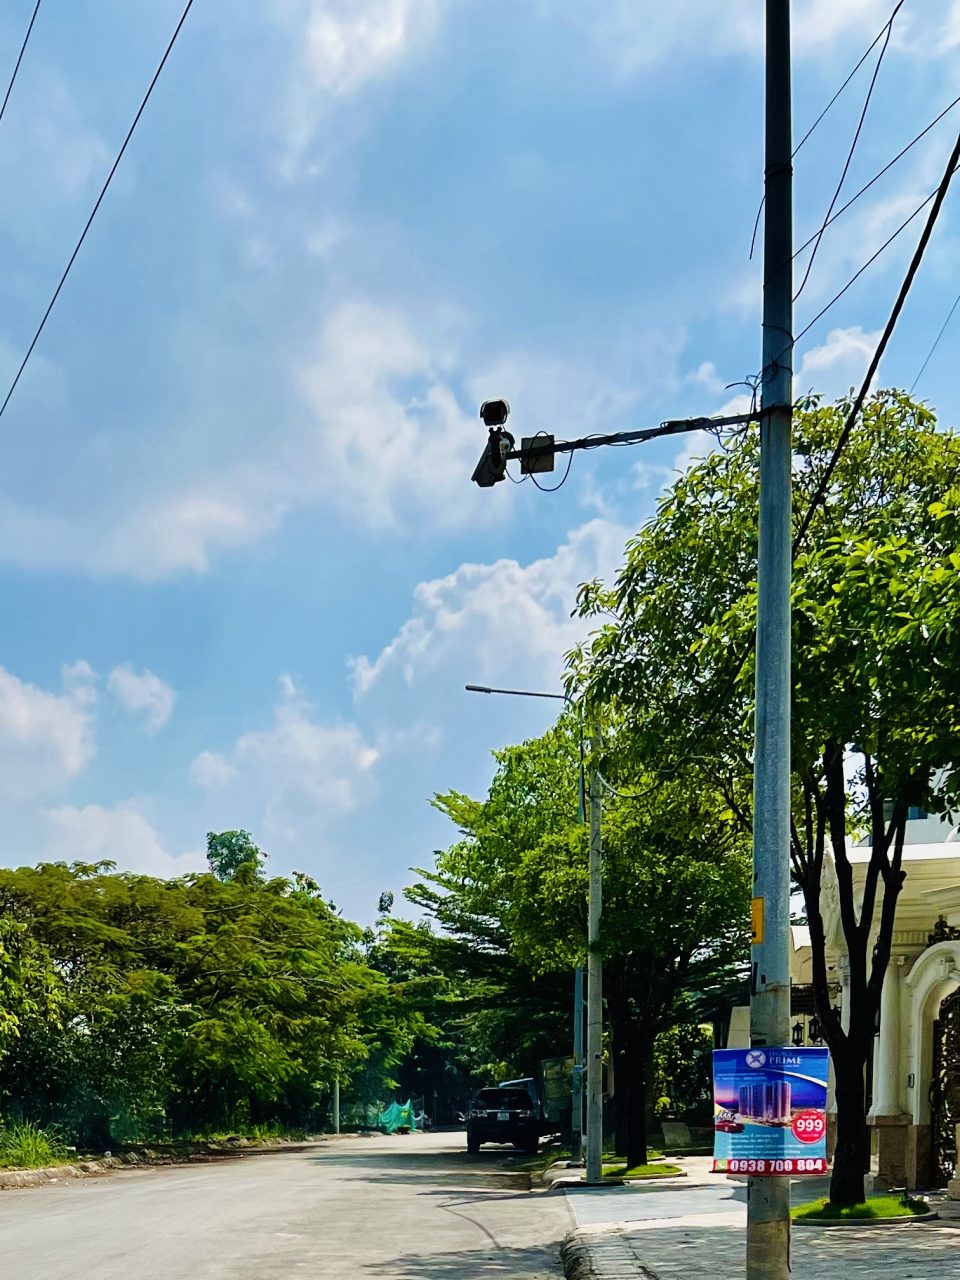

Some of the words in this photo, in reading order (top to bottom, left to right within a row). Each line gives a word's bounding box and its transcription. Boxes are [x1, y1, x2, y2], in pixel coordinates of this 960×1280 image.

[769, 1056, 802, 1064] PRIME
[796, 1119, 823, 1132] 999
[730, 1160, 765, 1171] 0938
[769, 1160, 792, 1171] 700
[797, 1159, 823, 1171] 804
